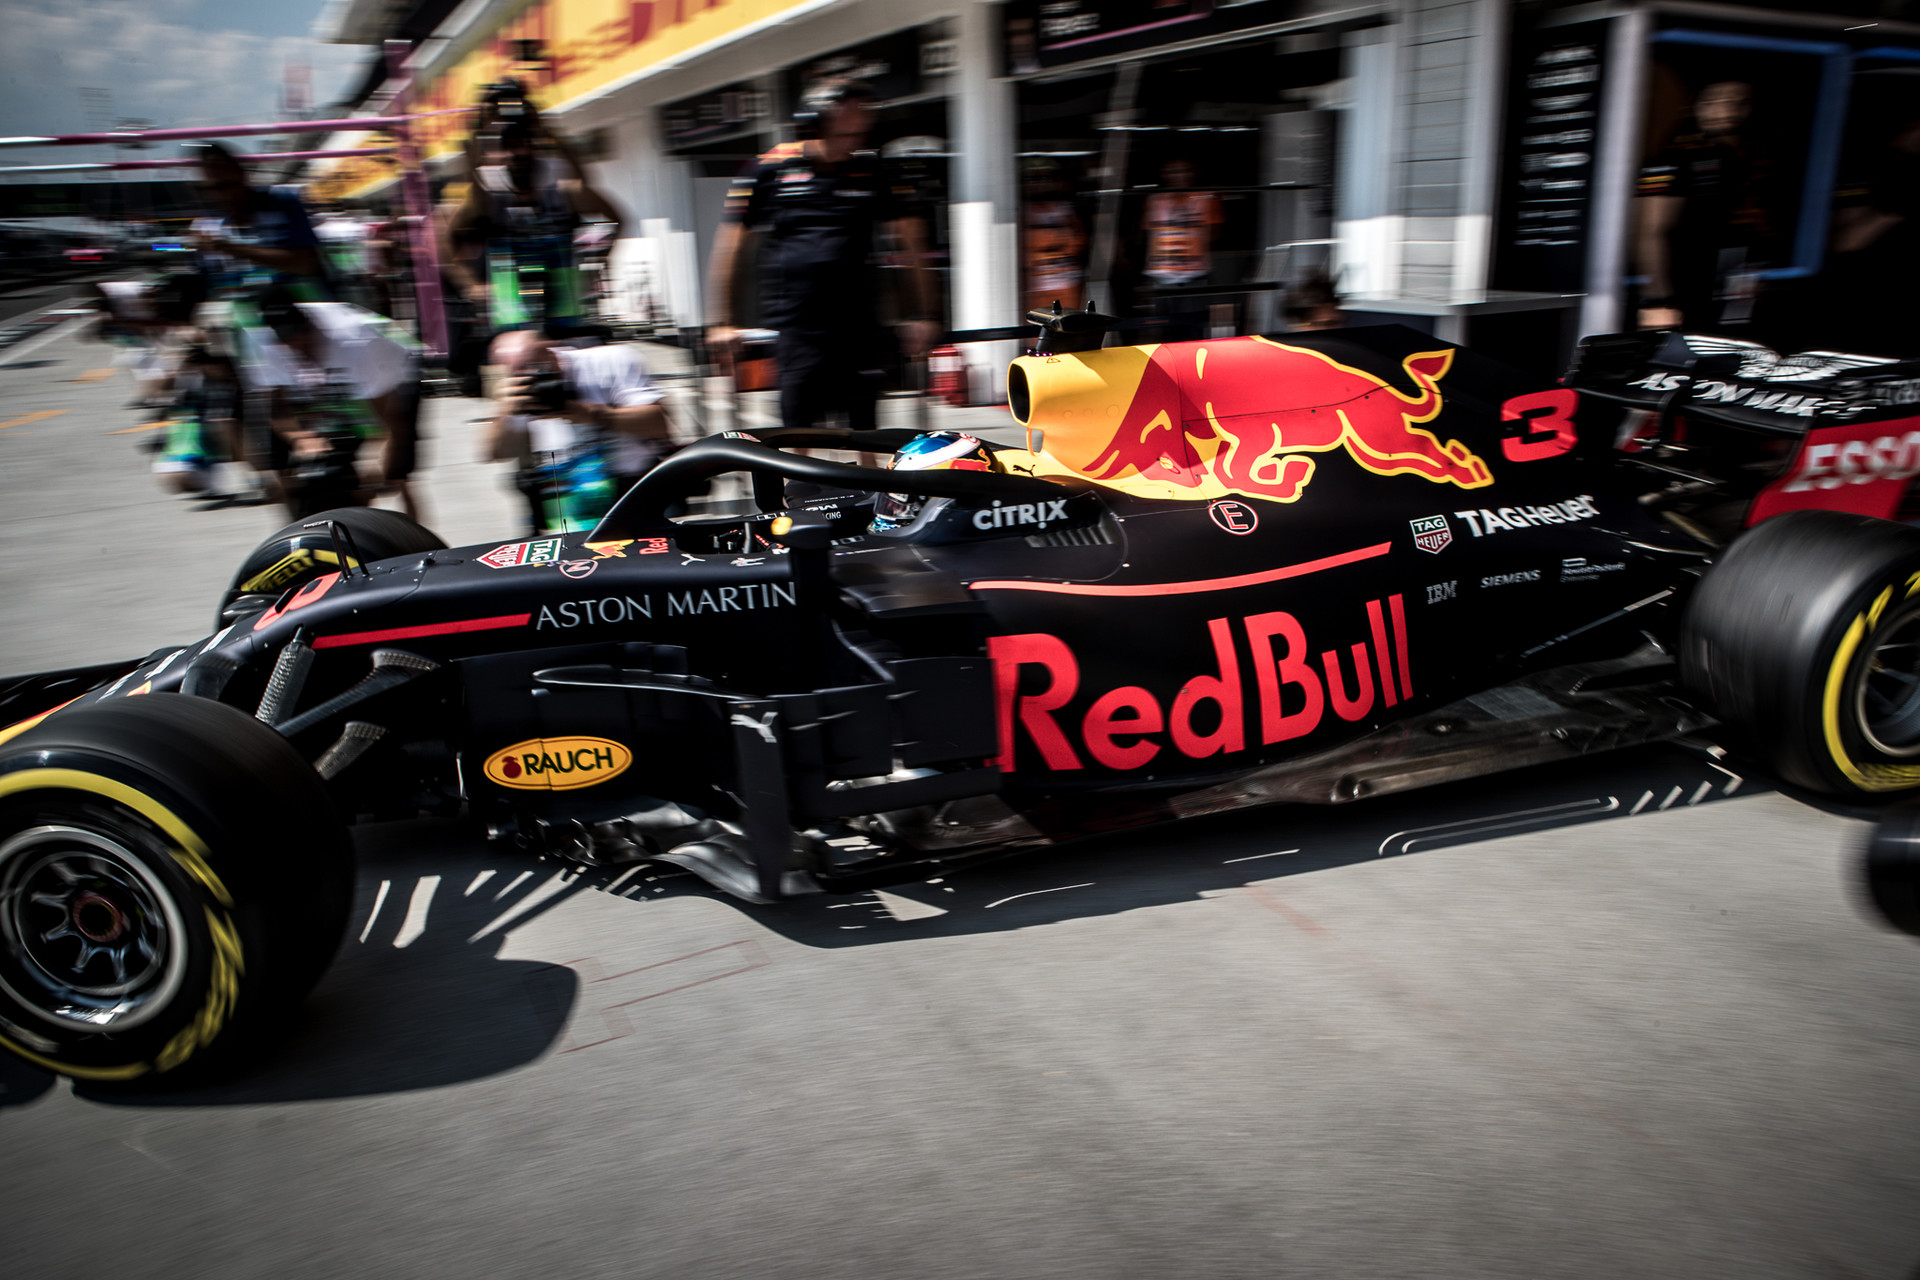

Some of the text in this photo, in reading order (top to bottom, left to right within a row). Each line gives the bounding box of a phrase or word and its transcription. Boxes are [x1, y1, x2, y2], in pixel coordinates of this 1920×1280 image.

[1627, 372, 1755, 402] ASON
[1501, 388, 1579, 463] 3
[822, 510, 842, 520] CING
[1218, 503, 1250, 530] E
[1413, 518, 1445, 532] TAG
[530, 540, 554, 563] TAG
[637, 537, 670, 555] Red
[1417, 532, 1449, 550] HEUER
[487, 544, 521, 567] HEUER
[1480, 569, 1541, 588] SIEMENS
[1426, 580, 1457, 605] IBM
[536, 581, 797, 630] ASTON MARTIN
[522, 747, 614, 775] RAUCH
